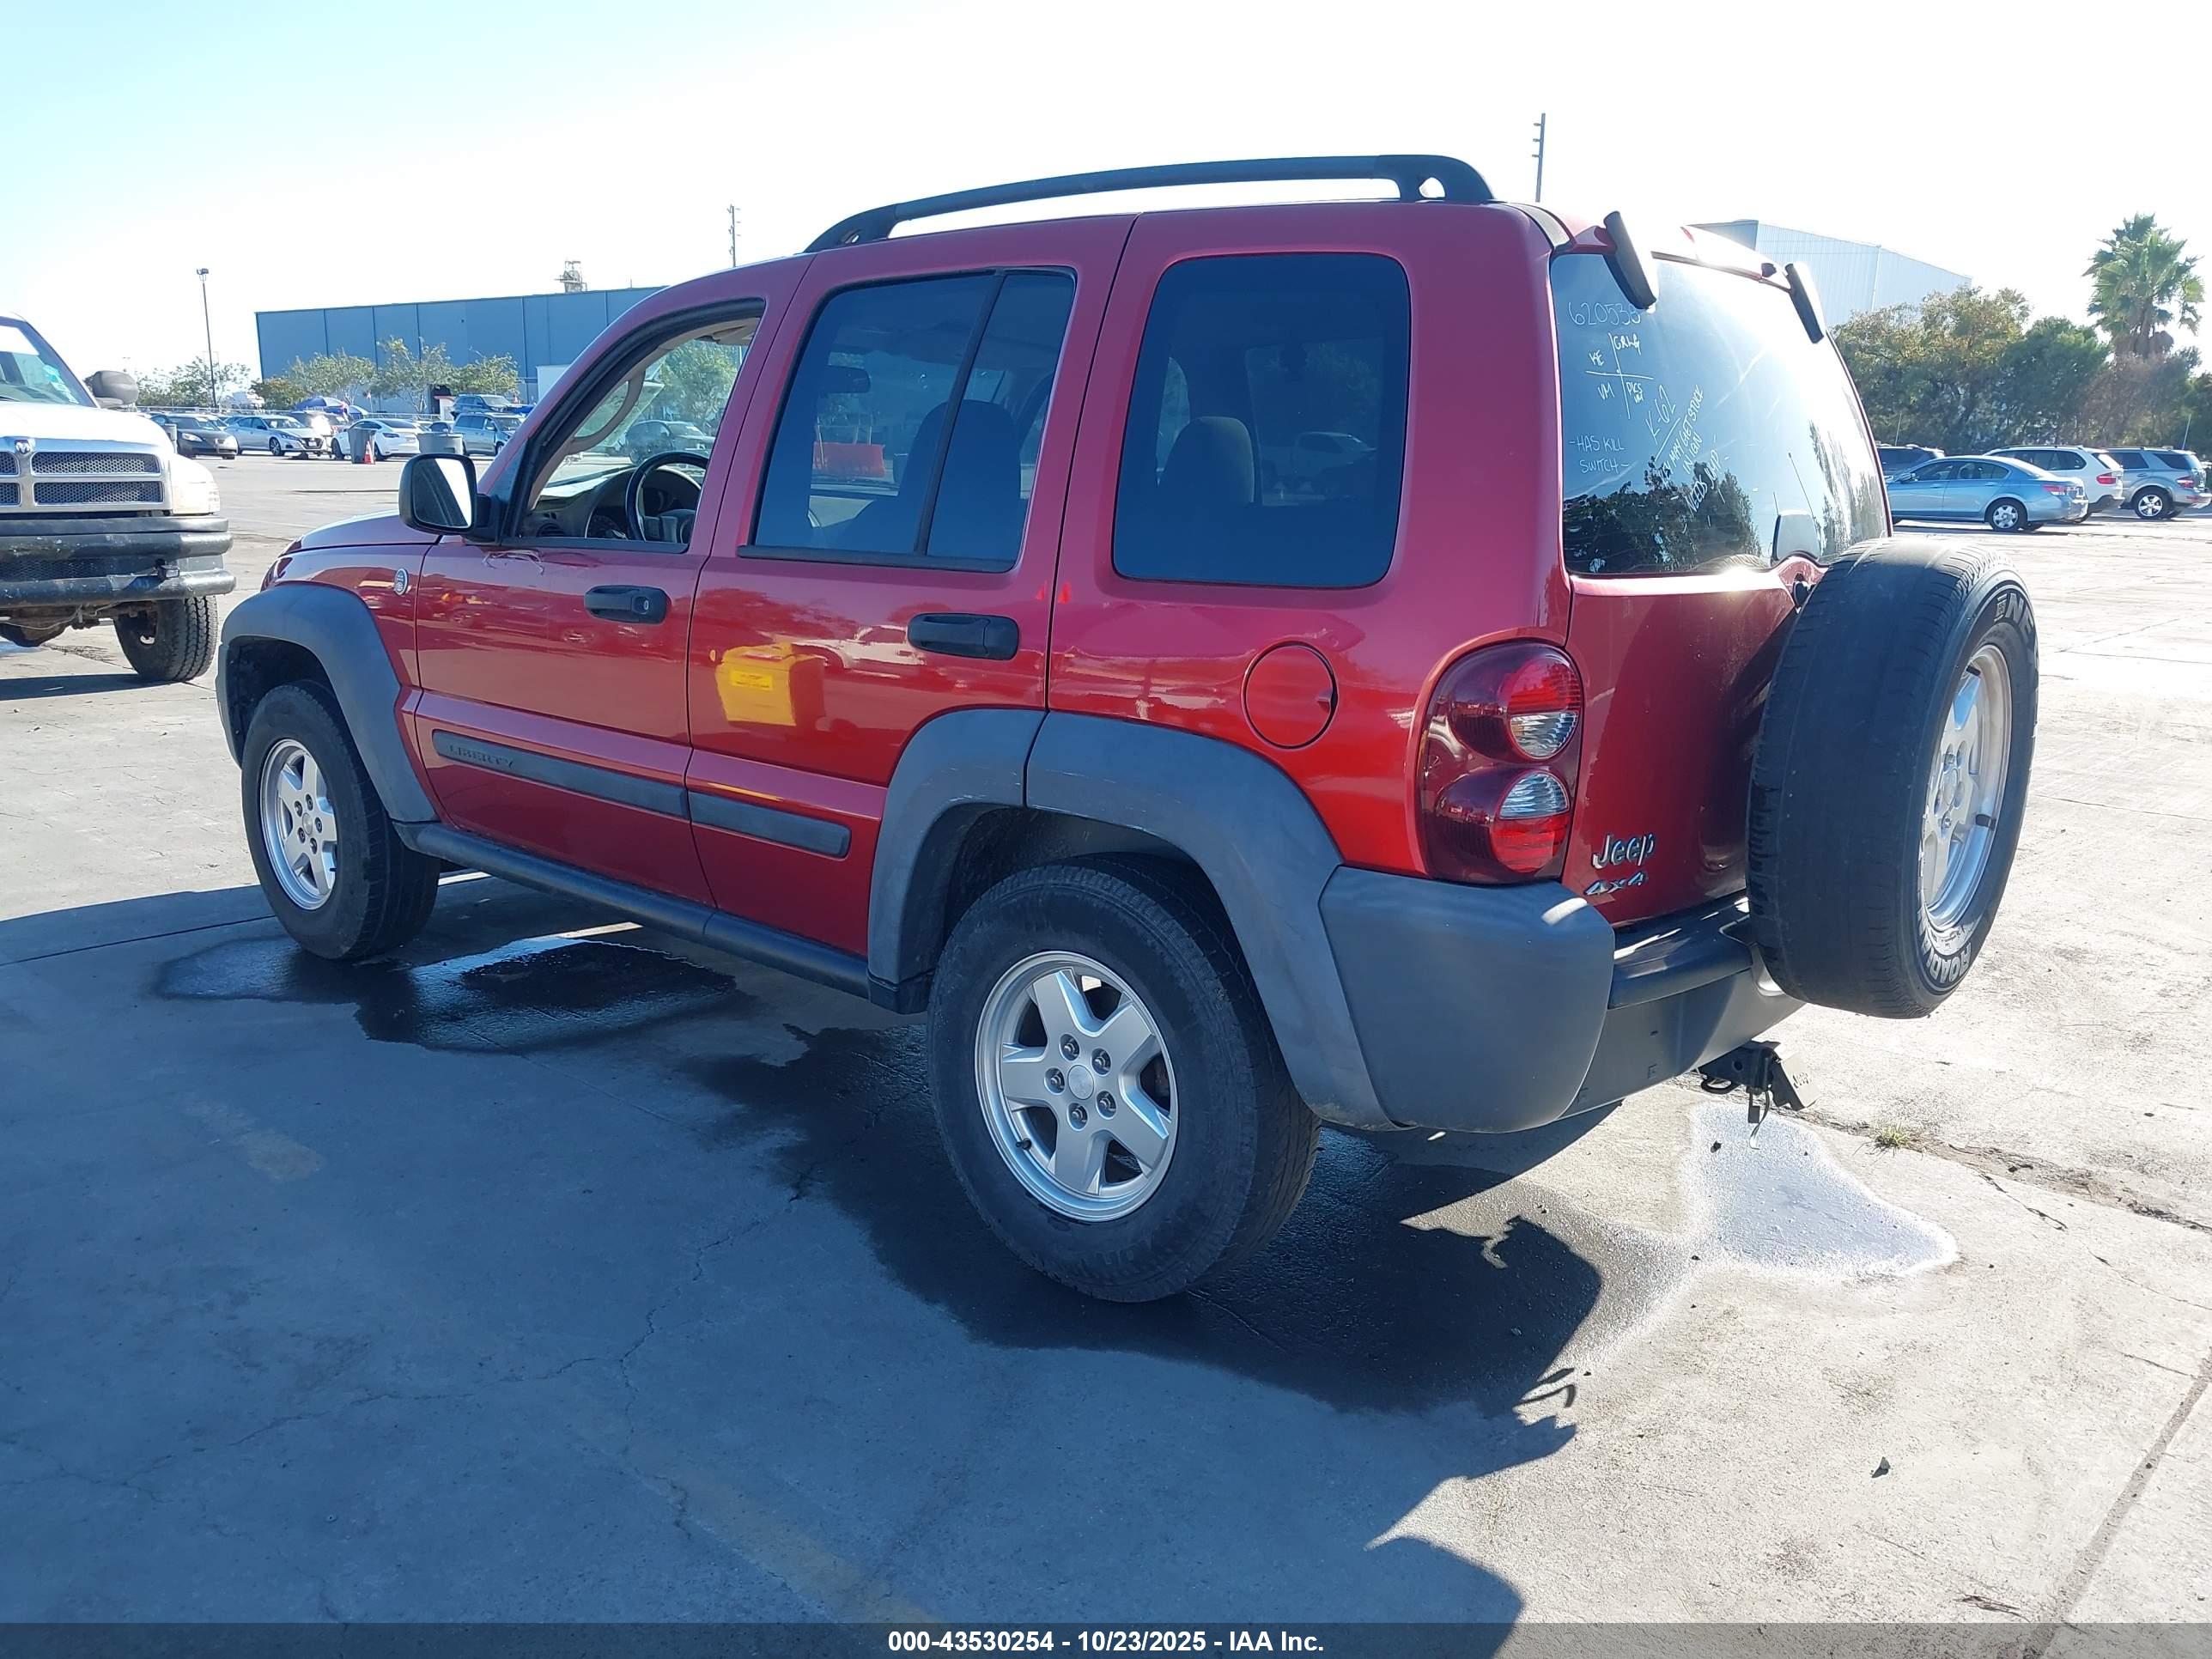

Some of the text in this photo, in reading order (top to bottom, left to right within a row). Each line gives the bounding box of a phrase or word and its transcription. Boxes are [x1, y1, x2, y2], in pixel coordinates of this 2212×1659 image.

[1602, 435, 1628, 453] KILL
[1668, 437, 1685, 468] MAY
[1679, 414, 1692, 447] GET
[1687, 384, 1704, 422] STUCK
[1682, 431, 1703, 475] IN IGN
[1684, 474, 1707, 516] NEEDS
[449, 744, 514, 769] LIBERTY
[1592, 833, 1655, 869] Jeep
